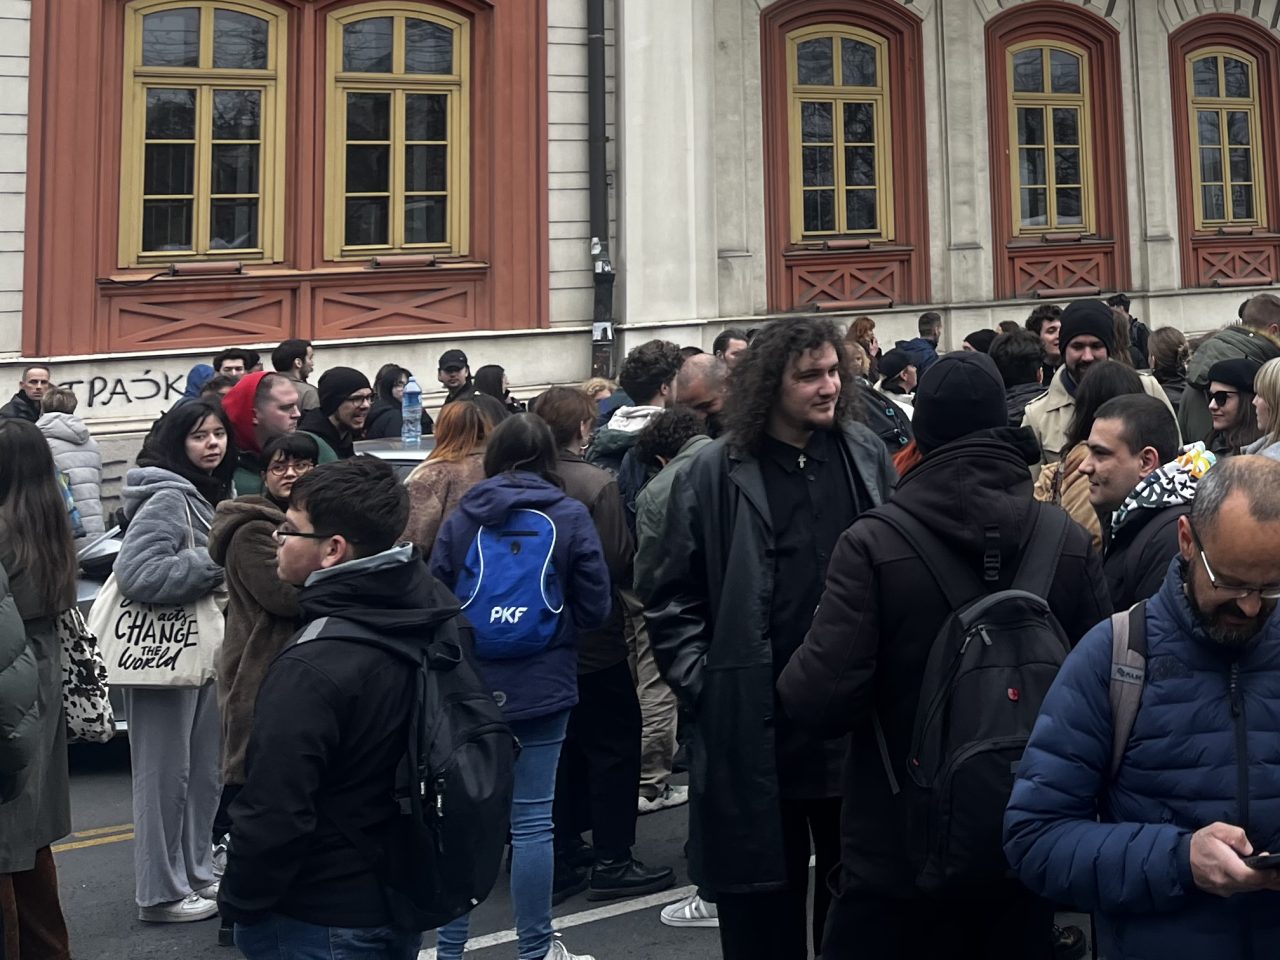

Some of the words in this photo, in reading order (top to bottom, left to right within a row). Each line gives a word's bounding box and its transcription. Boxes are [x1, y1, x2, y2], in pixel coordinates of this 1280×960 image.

[490, 606, 528, 624] PKF
[115, 610, 199, 648] CHANGE
[141, 645, 162, 657] THE
